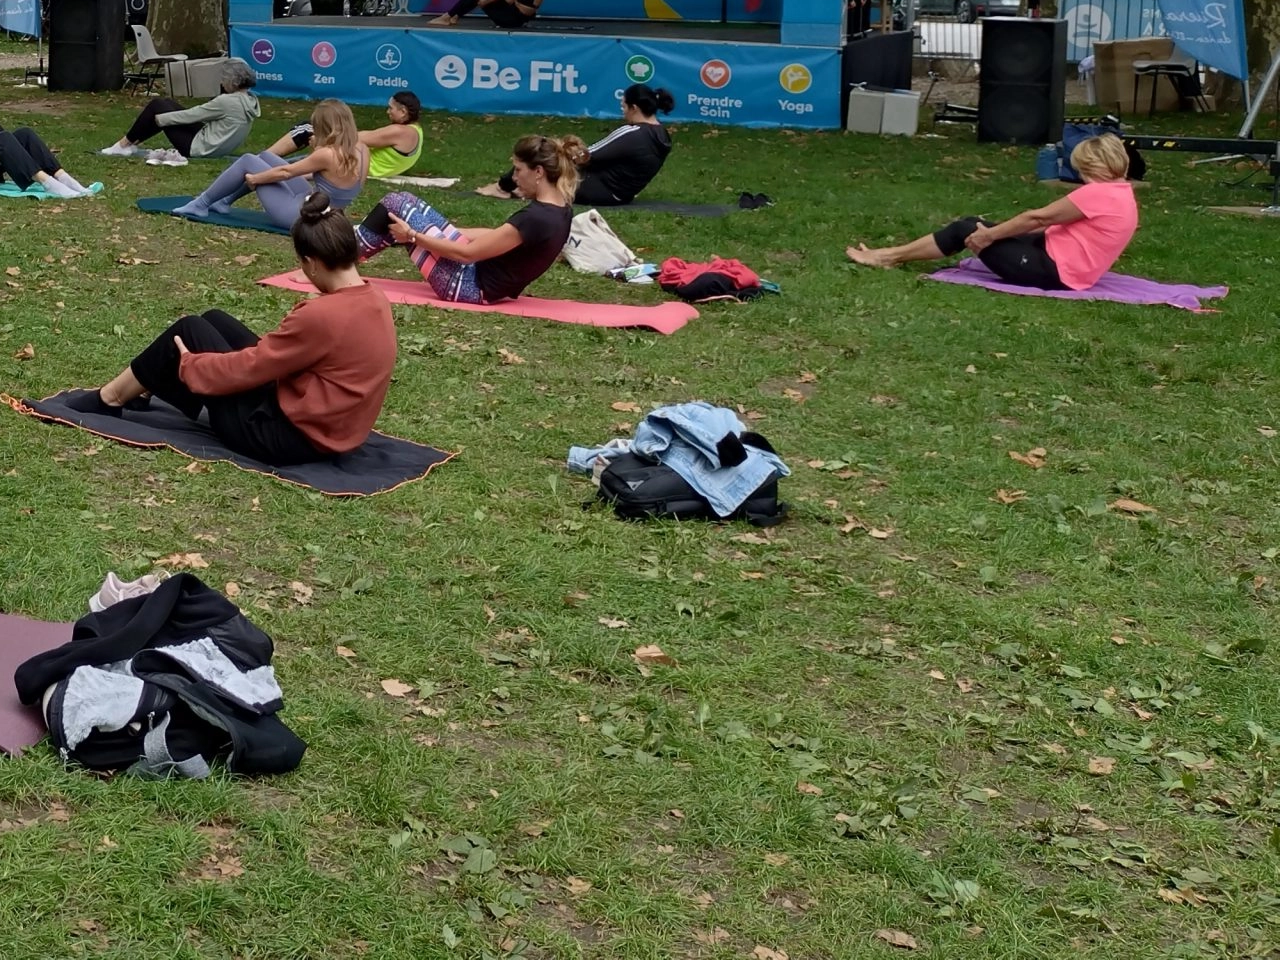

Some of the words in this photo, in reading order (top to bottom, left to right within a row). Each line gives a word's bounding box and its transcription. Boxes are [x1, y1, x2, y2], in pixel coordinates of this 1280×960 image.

[255, 70, 284, 81] tness
[313, 73, 336, 85] Zen
[472, 57, 521, 91] Be
[529, 60, 588, 94] Fit.
[368, 76, 409, 88] Paddle
[687, 93, 743, 108] Prendre
[778, 99, 814, 114] Yoga
[700, 106, 731, 118] Soin
